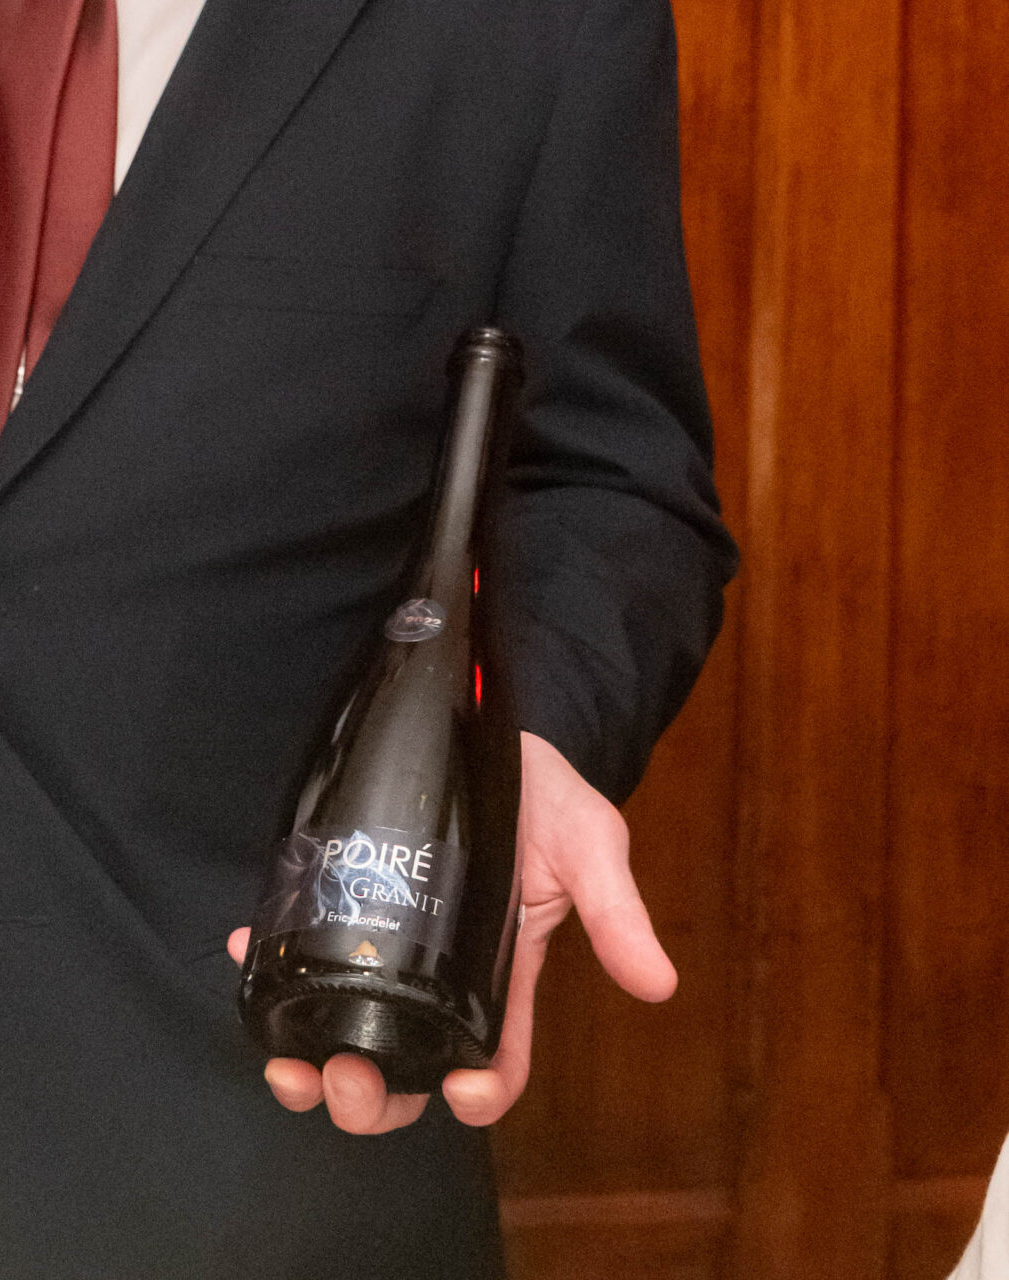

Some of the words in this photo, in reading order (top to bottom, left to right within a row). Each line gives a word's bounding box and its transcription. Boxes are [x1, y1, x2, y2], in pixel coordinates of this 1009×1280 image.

[321, 839, 434, 883] POIRÉ
[349, 877, 444, 916] GRANIT
[326, 911, 349, 923] Eric
